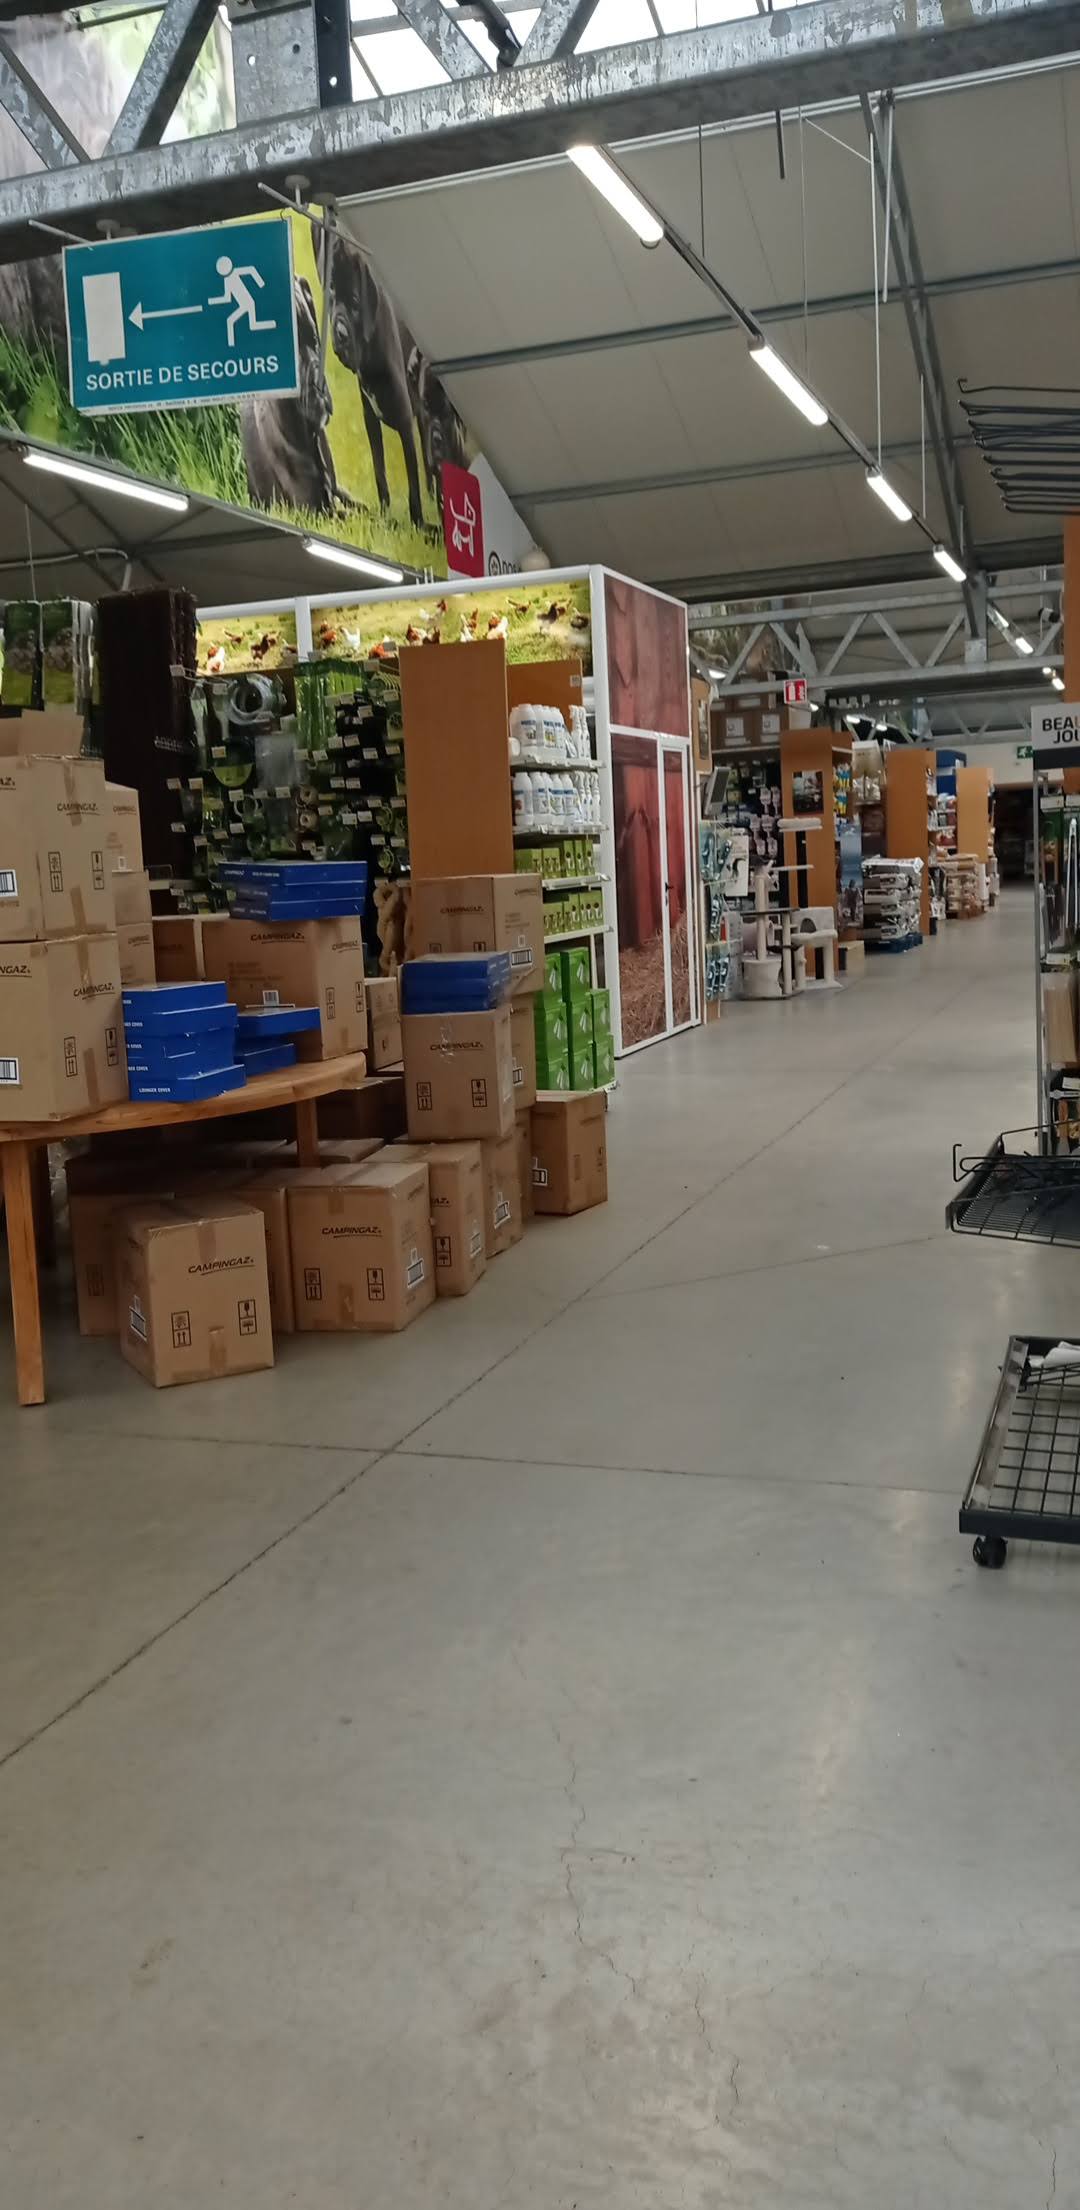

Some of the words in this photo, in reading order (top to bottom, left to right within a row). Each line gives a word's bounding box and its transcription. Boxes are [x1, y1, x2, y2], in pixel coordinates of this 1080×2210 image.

[86, 368, 153, 391] SORTIE
[158, 366, 183, 384] DE
[187, 355, 279, 381] SECOURS
[73, 982, 114, 997] CAMPINGAZ
[322, 1226, 381, 1236] CAMPINGAZ
[188, 1256, 253, 1274] CAMPINGAZ
